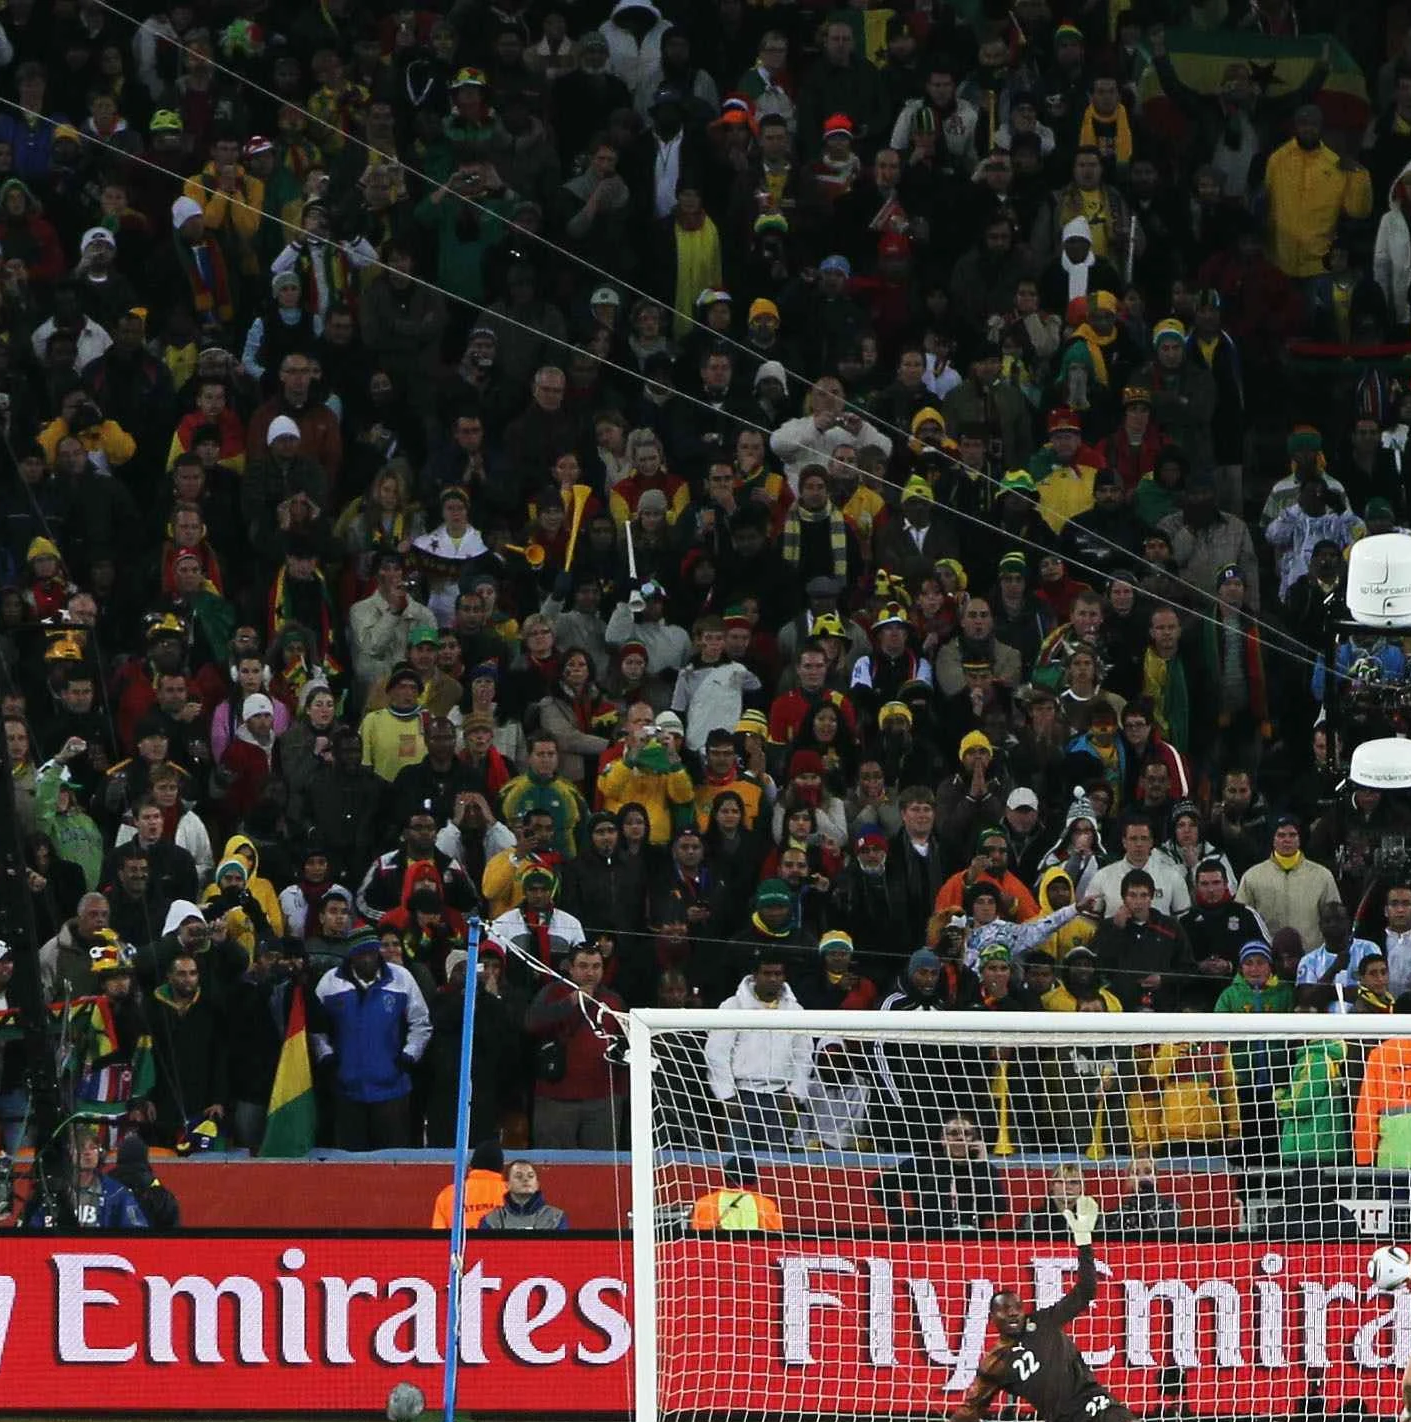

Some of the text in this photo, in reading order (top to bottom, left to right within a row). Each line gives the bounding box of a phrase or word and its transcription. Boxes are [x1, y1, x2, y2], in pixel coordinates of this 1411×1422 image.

[1352, 1209, 1384, 1231] IT
[52, 1248, 631, 1364] Emirates
[776, 1257, 994, 1391] Fly
[1012, 1350, 1040, 1382] 22
